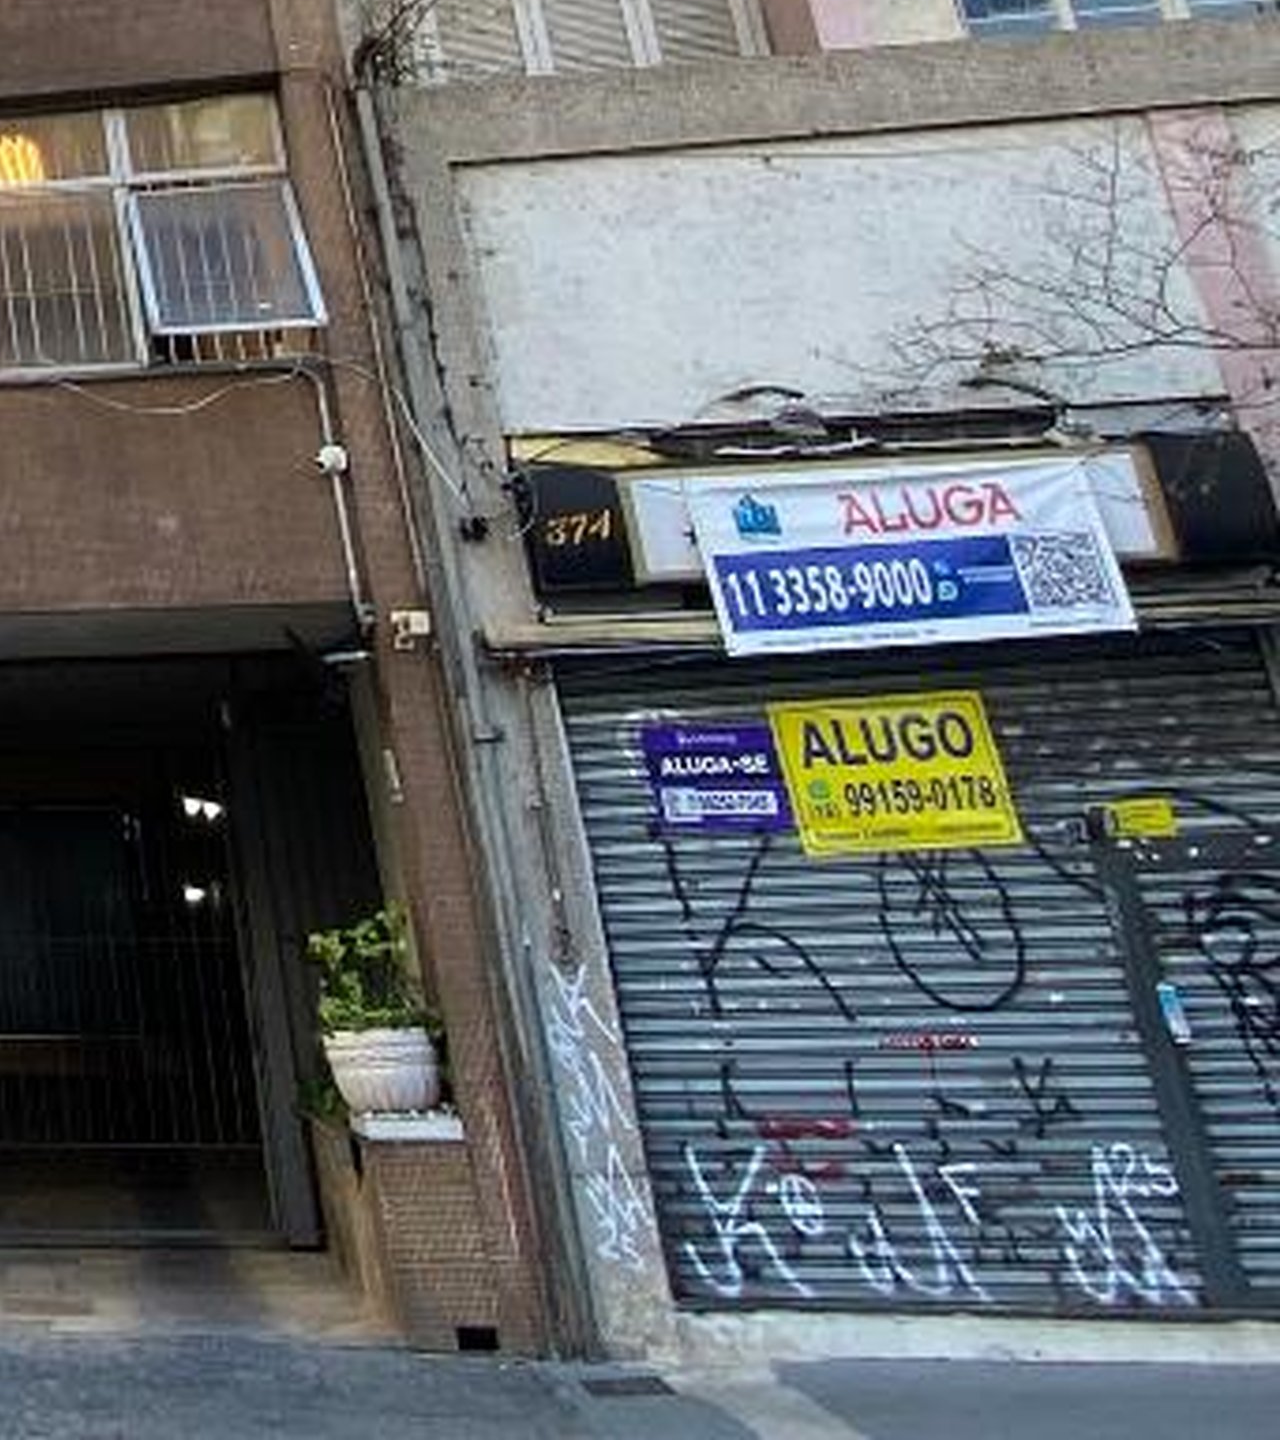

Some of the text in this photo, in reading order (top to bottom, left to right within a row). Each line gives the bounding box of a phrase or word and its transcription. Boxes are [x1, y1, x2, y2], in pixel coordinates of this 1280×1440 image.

[545, 509, 610, 545] 374
[838, 482, 1021, 536] ALUGA
[728, 558, 932, 616] 11 3358-9000
[801, 711, 975, 769] ALUGO
[661, 753, 771, 776] ALUGA-SE
[844, 775, 997, 817] 99159-0178
